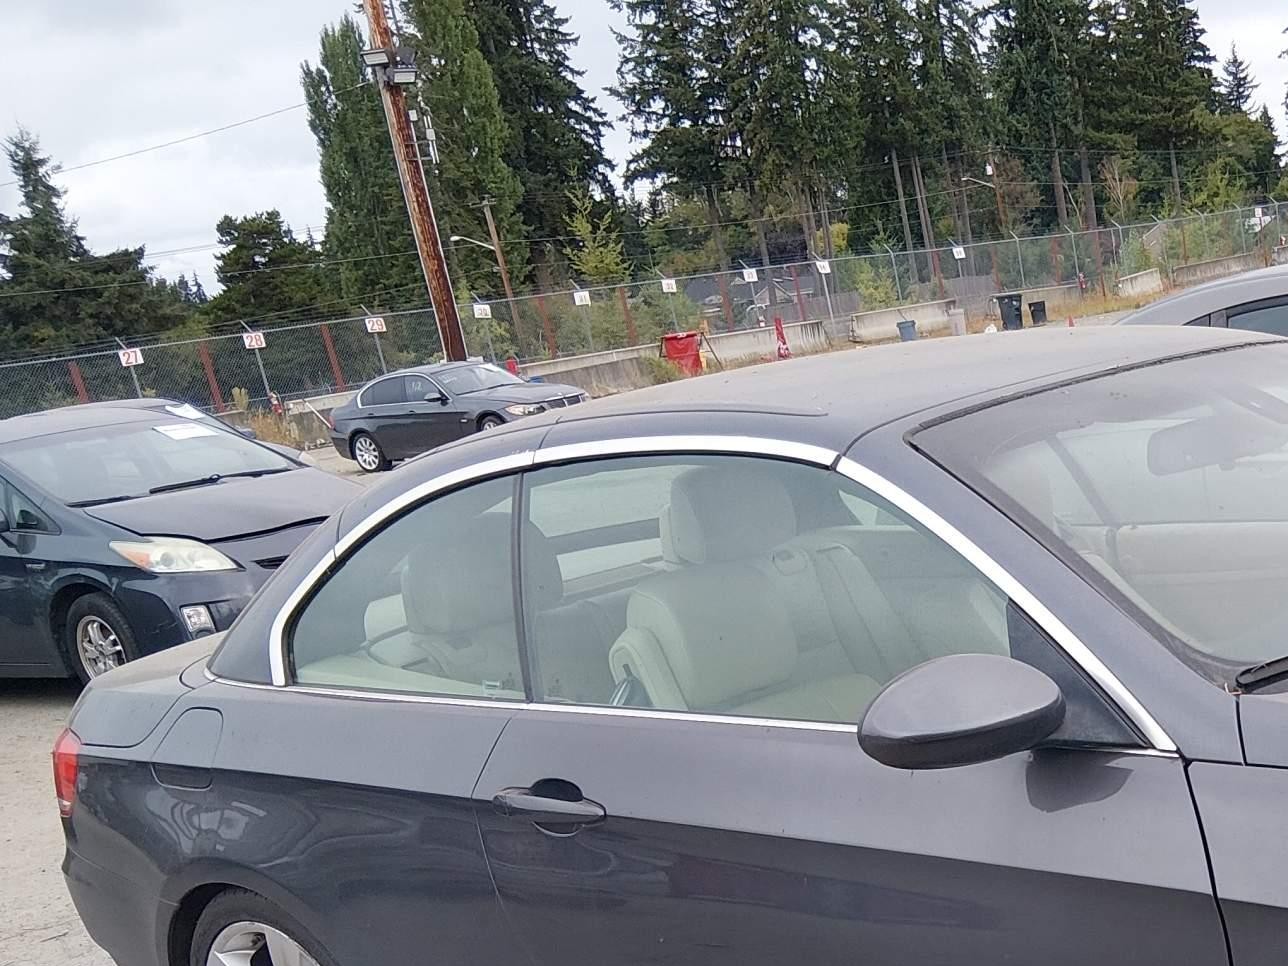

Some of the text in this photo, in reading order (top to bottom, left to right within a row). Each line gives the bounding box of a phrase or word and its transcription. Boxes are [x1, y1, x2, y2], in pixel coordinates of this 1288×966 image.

[368, 319, 384, 331] 29
[246, 335, 263, 347] 28
[122, 350, 138, 364] 27
